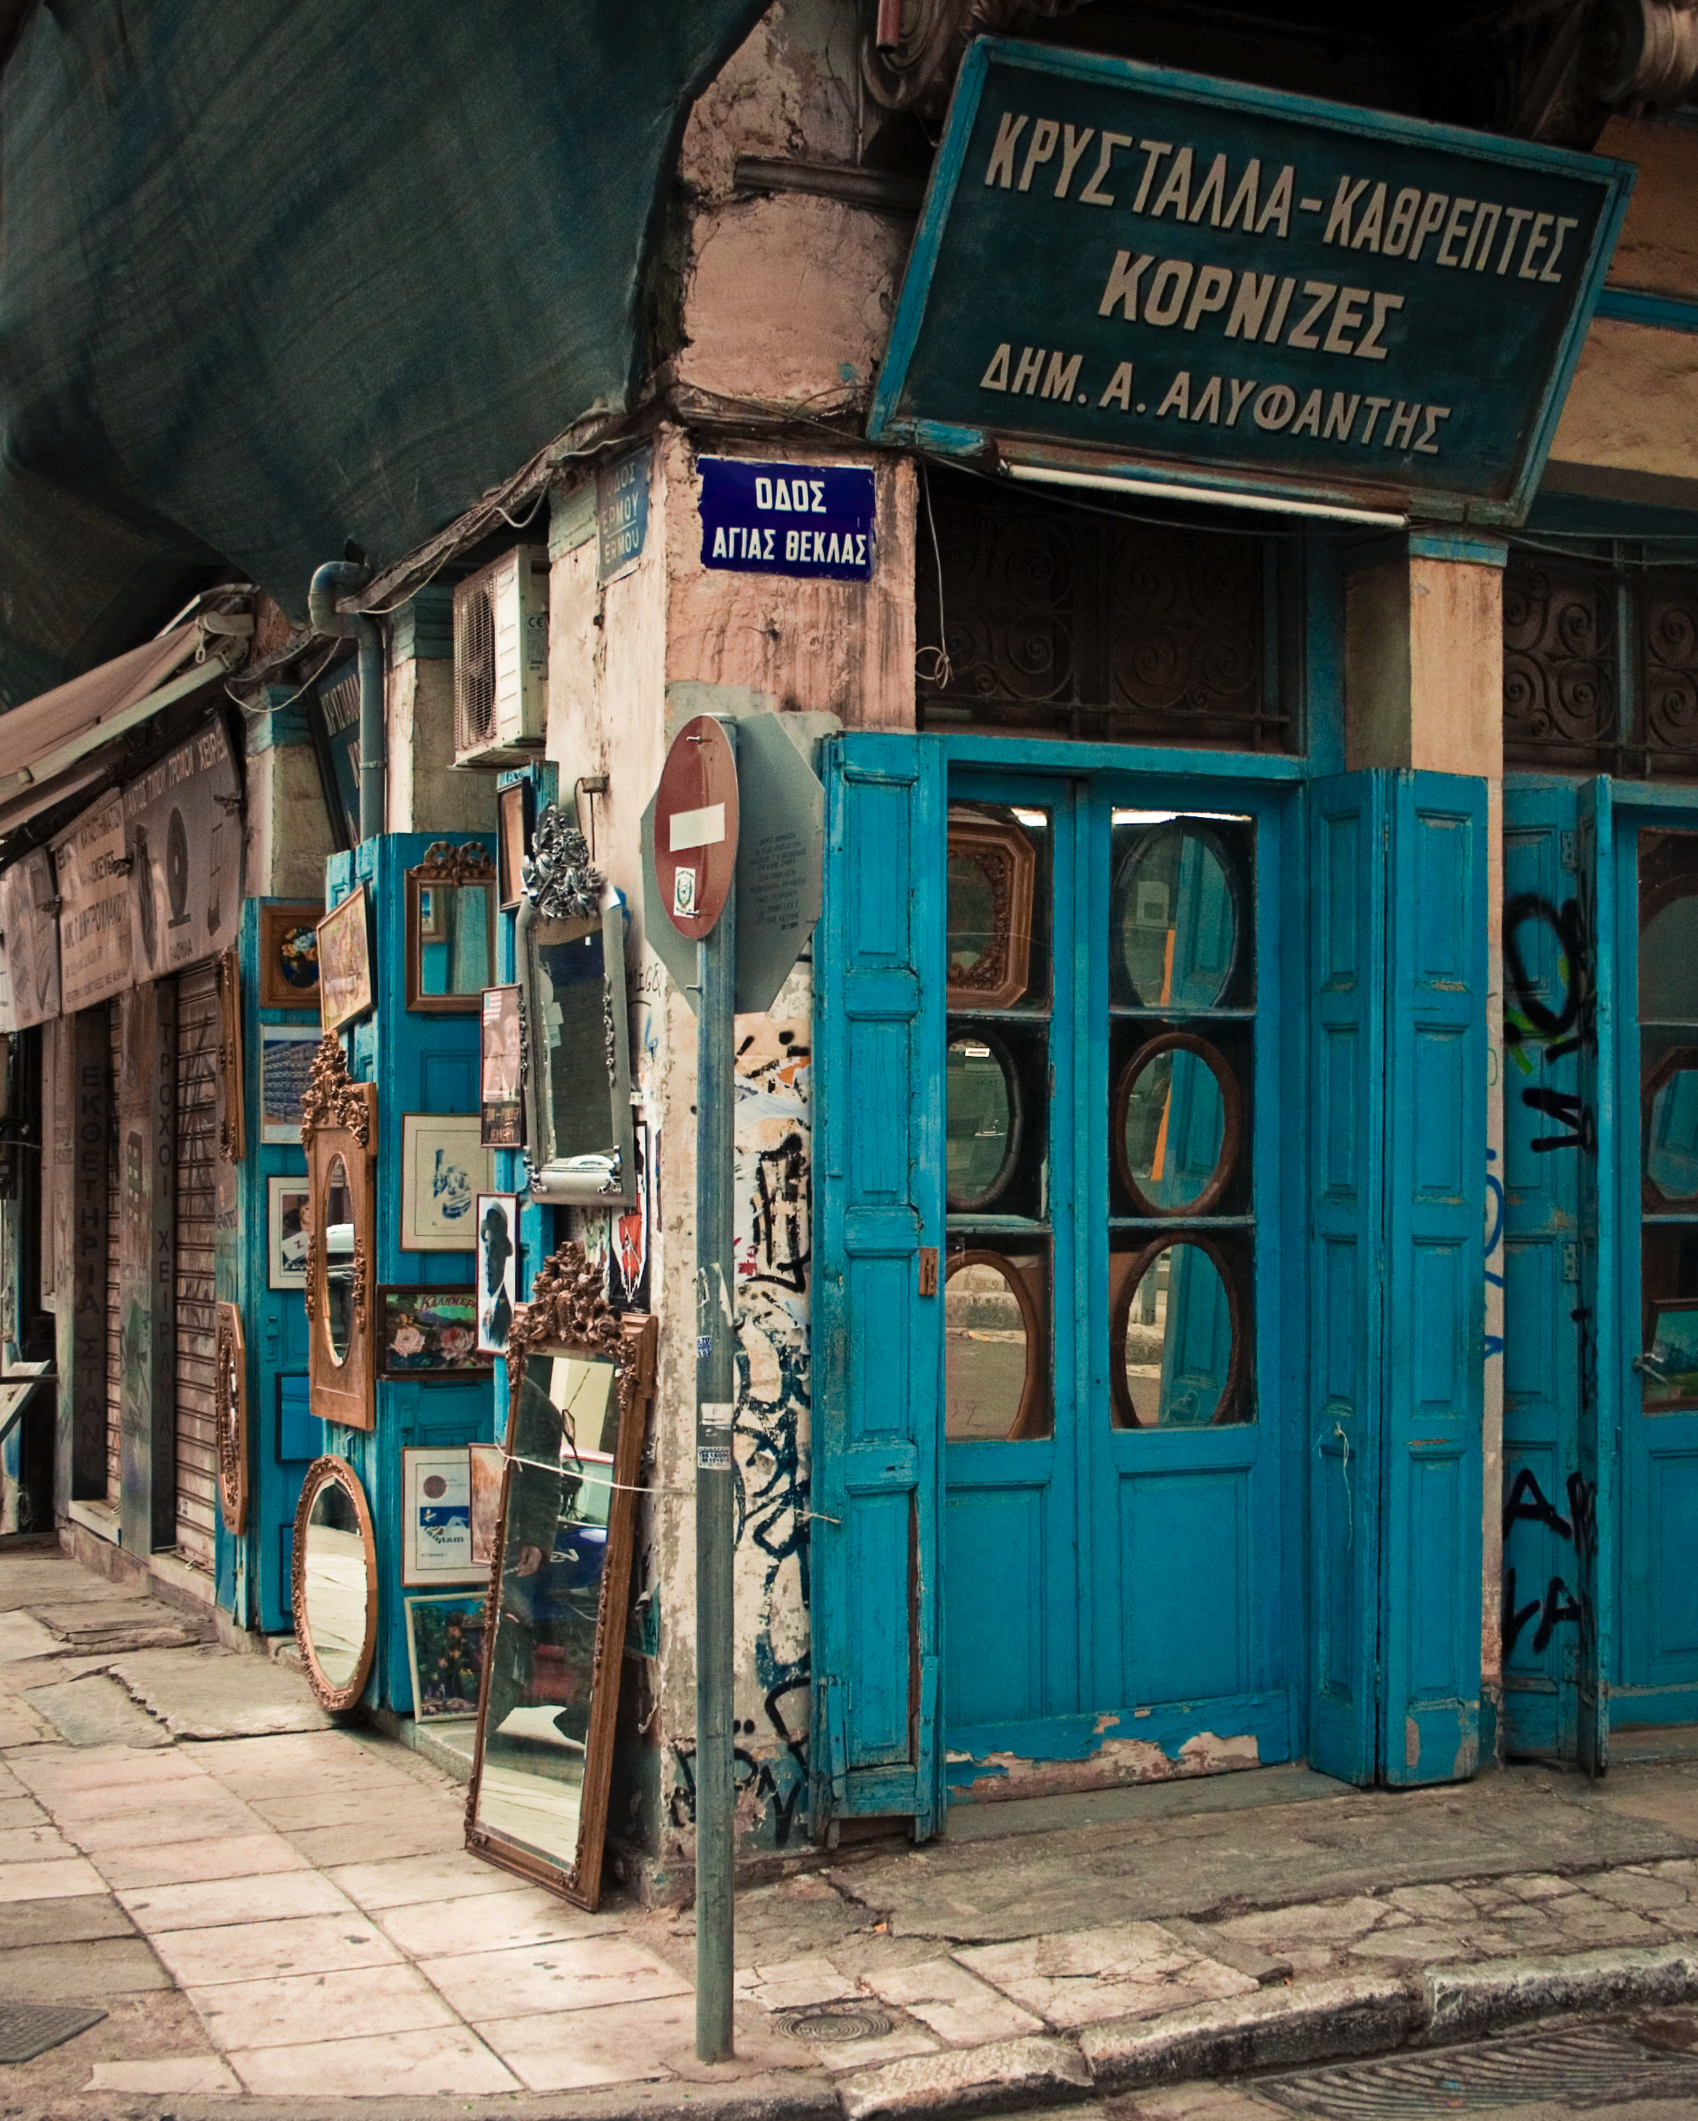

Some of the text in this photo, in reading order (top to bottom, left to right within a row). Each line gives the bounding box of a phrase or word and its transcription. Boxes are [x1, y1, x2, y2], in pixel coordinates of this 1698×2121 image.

[1097, 250, 1406, 361] ΚΟΡΝΙΖΕΣ
[979, 343, 1453, 456] ΔΗΜ. Α. ΑΛΥΦΑΝΤΗΣ
[605, 462, 636, 497] ΟΔΟΣ
[755, 477, 827, 514] ΟΔΟΣ
[602, 492, 639, 535] ΕΡΜΟΥ
[604, 526, 640, 564] ERMOU
[712, 527, 867, 565] ΑΓΙΑΣ ΘΕΚΛΑΣ
[158, 1022, 173, 1197] ΤΡΟΧΟΙ
[79, 1065, 103, 1315] ΕΚΘΕΤΗΡΙΑ
